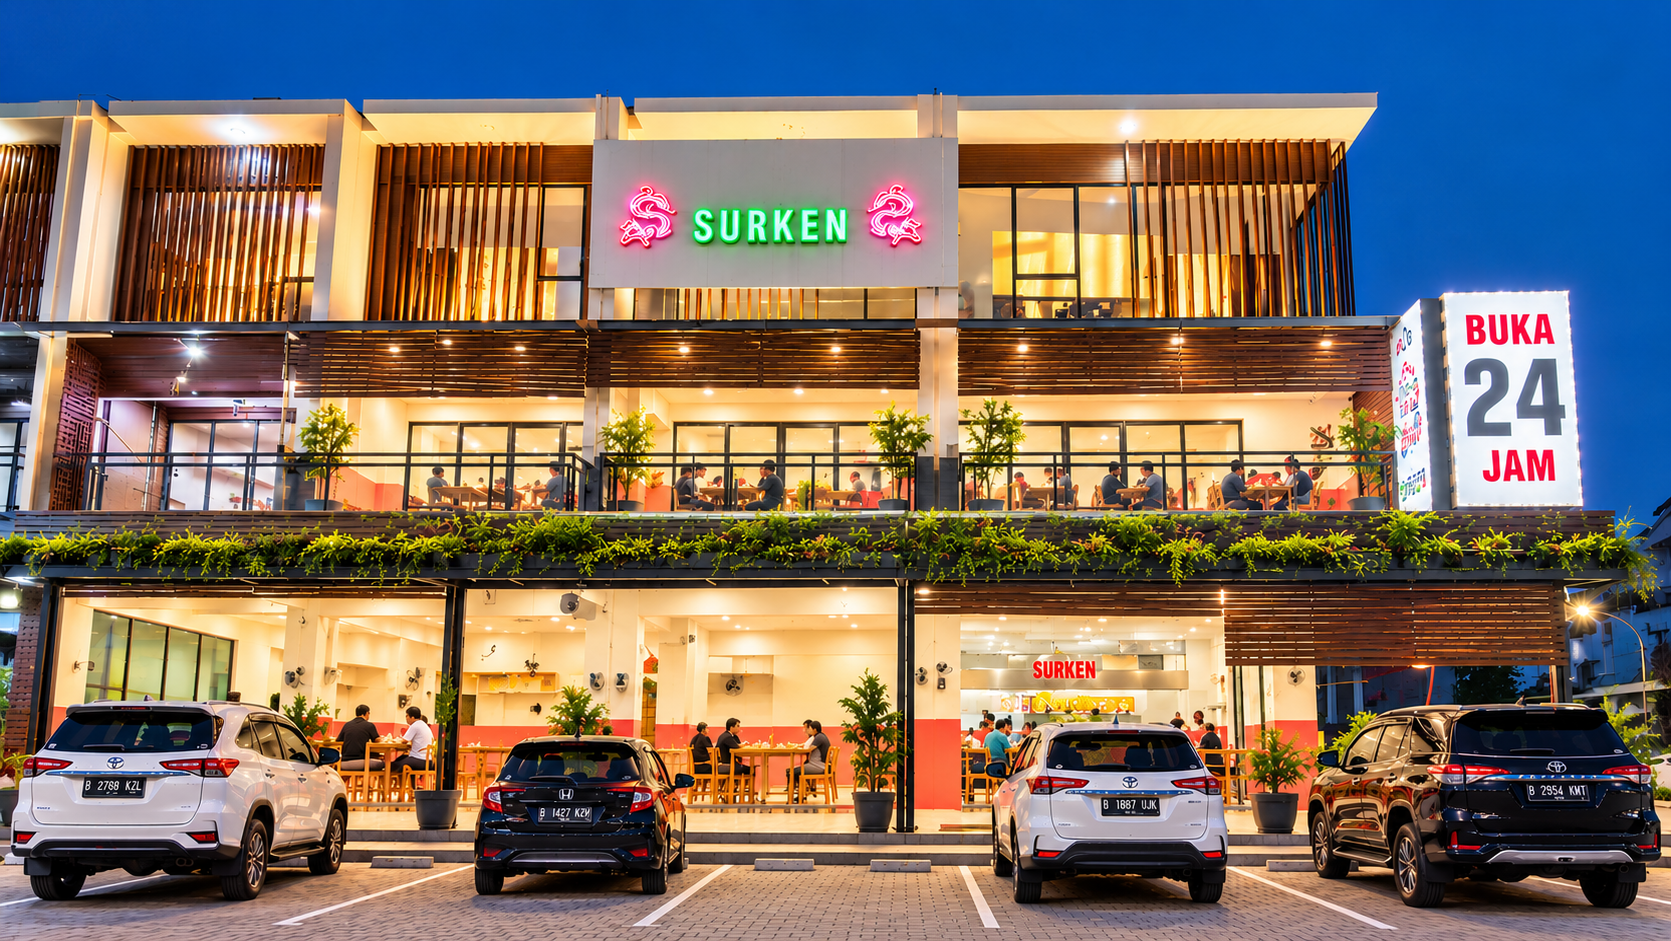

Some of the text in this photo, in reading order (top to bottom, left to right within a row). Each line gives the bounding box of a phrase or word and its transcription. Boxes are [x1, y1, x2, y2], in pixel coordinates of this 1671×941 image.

[693, 208, 848, 244] SURKEN
[1465, 313, 1556, 346] BUKA
[1463, 357, 1566, 437] 24
[1482, 449, 1556, 482] JAM
[1032, 660, 1096, 680] SURKEN
[85, 780, 92, 791] B
[125, 780, 142, 791] KZL
[1528, 785, 1535, 796] B
[540, 807, 546, 818] B
[552, 807, 572, 818] 1427
[1103, 799, 1109, 810] B
[1141, 799, 1158, 810] UJK
